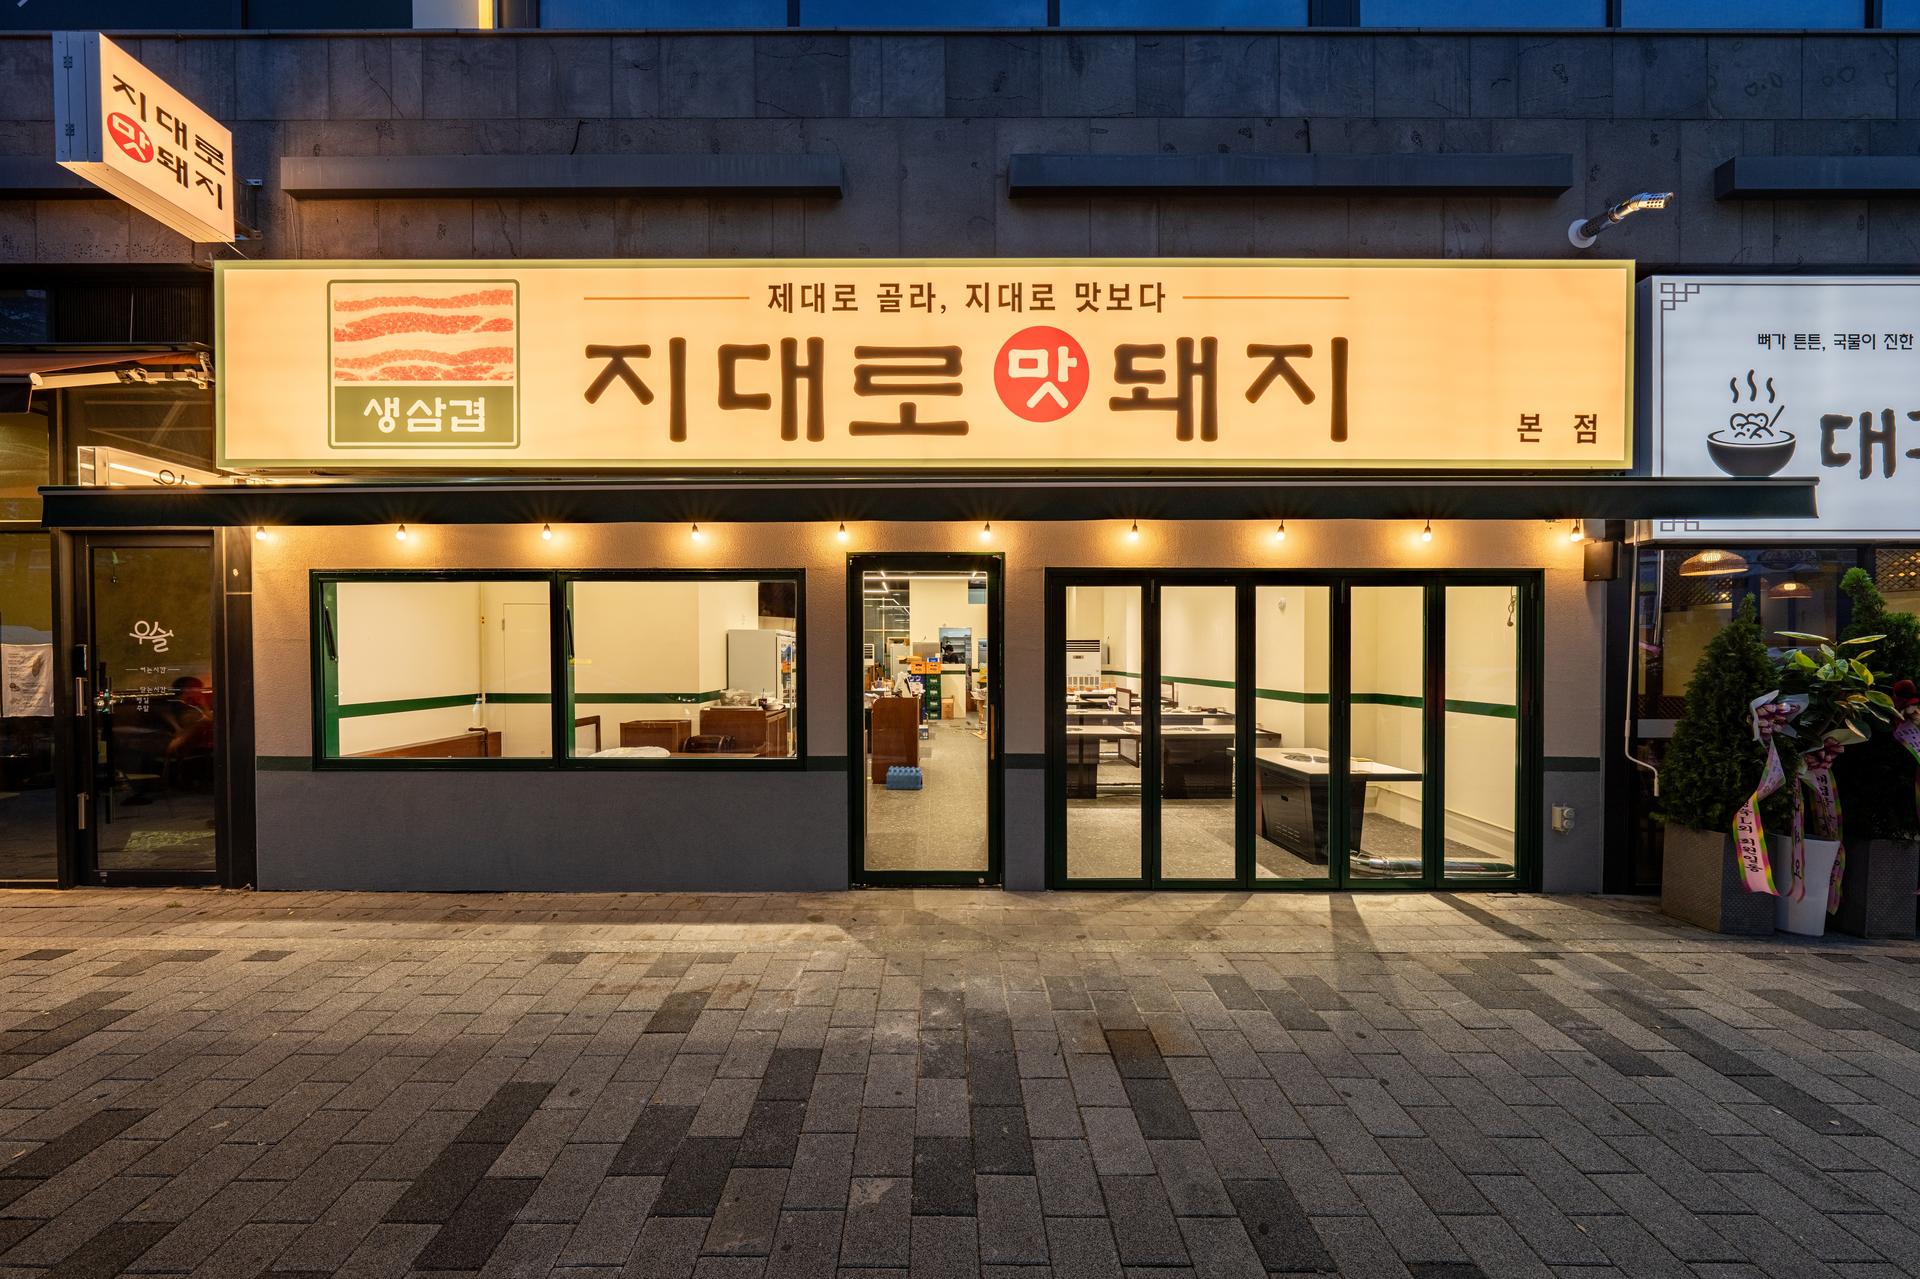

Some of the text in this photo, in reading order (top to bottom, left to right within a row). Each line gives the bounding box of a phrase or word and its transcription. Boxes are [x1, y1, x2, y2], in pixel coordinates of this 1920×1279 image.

[112, 73, 226, 176] 지대로
[111, 113, 223, 211] 맛돼지
[767, 282, 1167, 314] 제대로 골라, 지대로 맛보다
[1757, 333, 1914, 352] 뼈가 튼튼, 국물이 진한
[363, 396, 486, 434] 생삼겹
